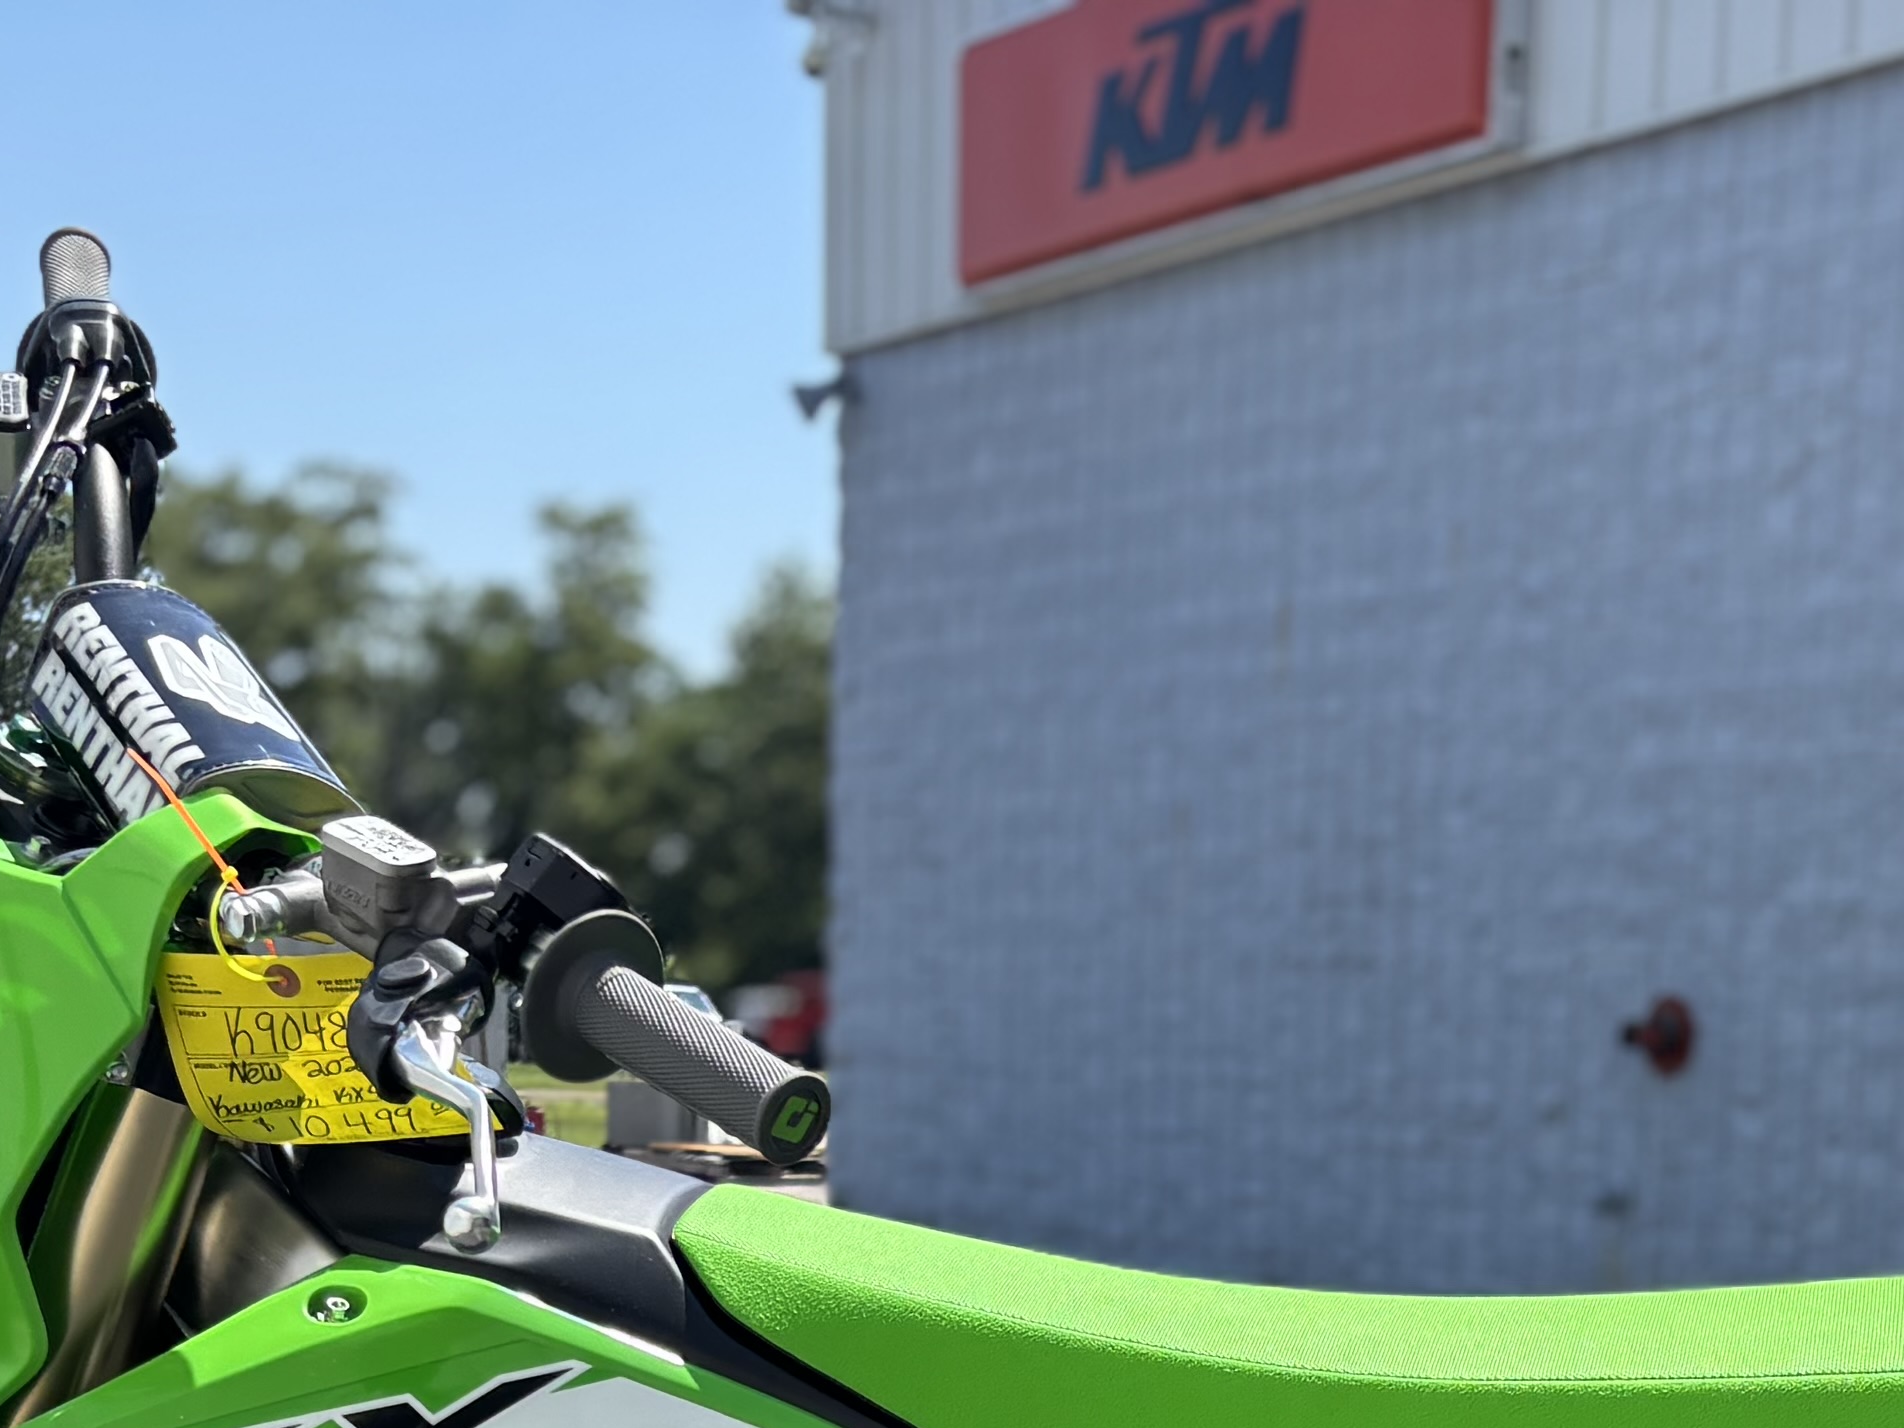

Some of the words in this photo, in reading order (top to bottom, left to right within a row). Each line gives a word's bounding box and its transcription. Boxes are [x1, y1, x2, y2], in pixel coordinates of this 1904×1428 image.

[1080, 0, 1306, 194] KTM
[53, 601, 206, 798] RENTHAL
[207, 1093, 319, 1119] Kawasaki
[230, 1060, 282, 1085] New
